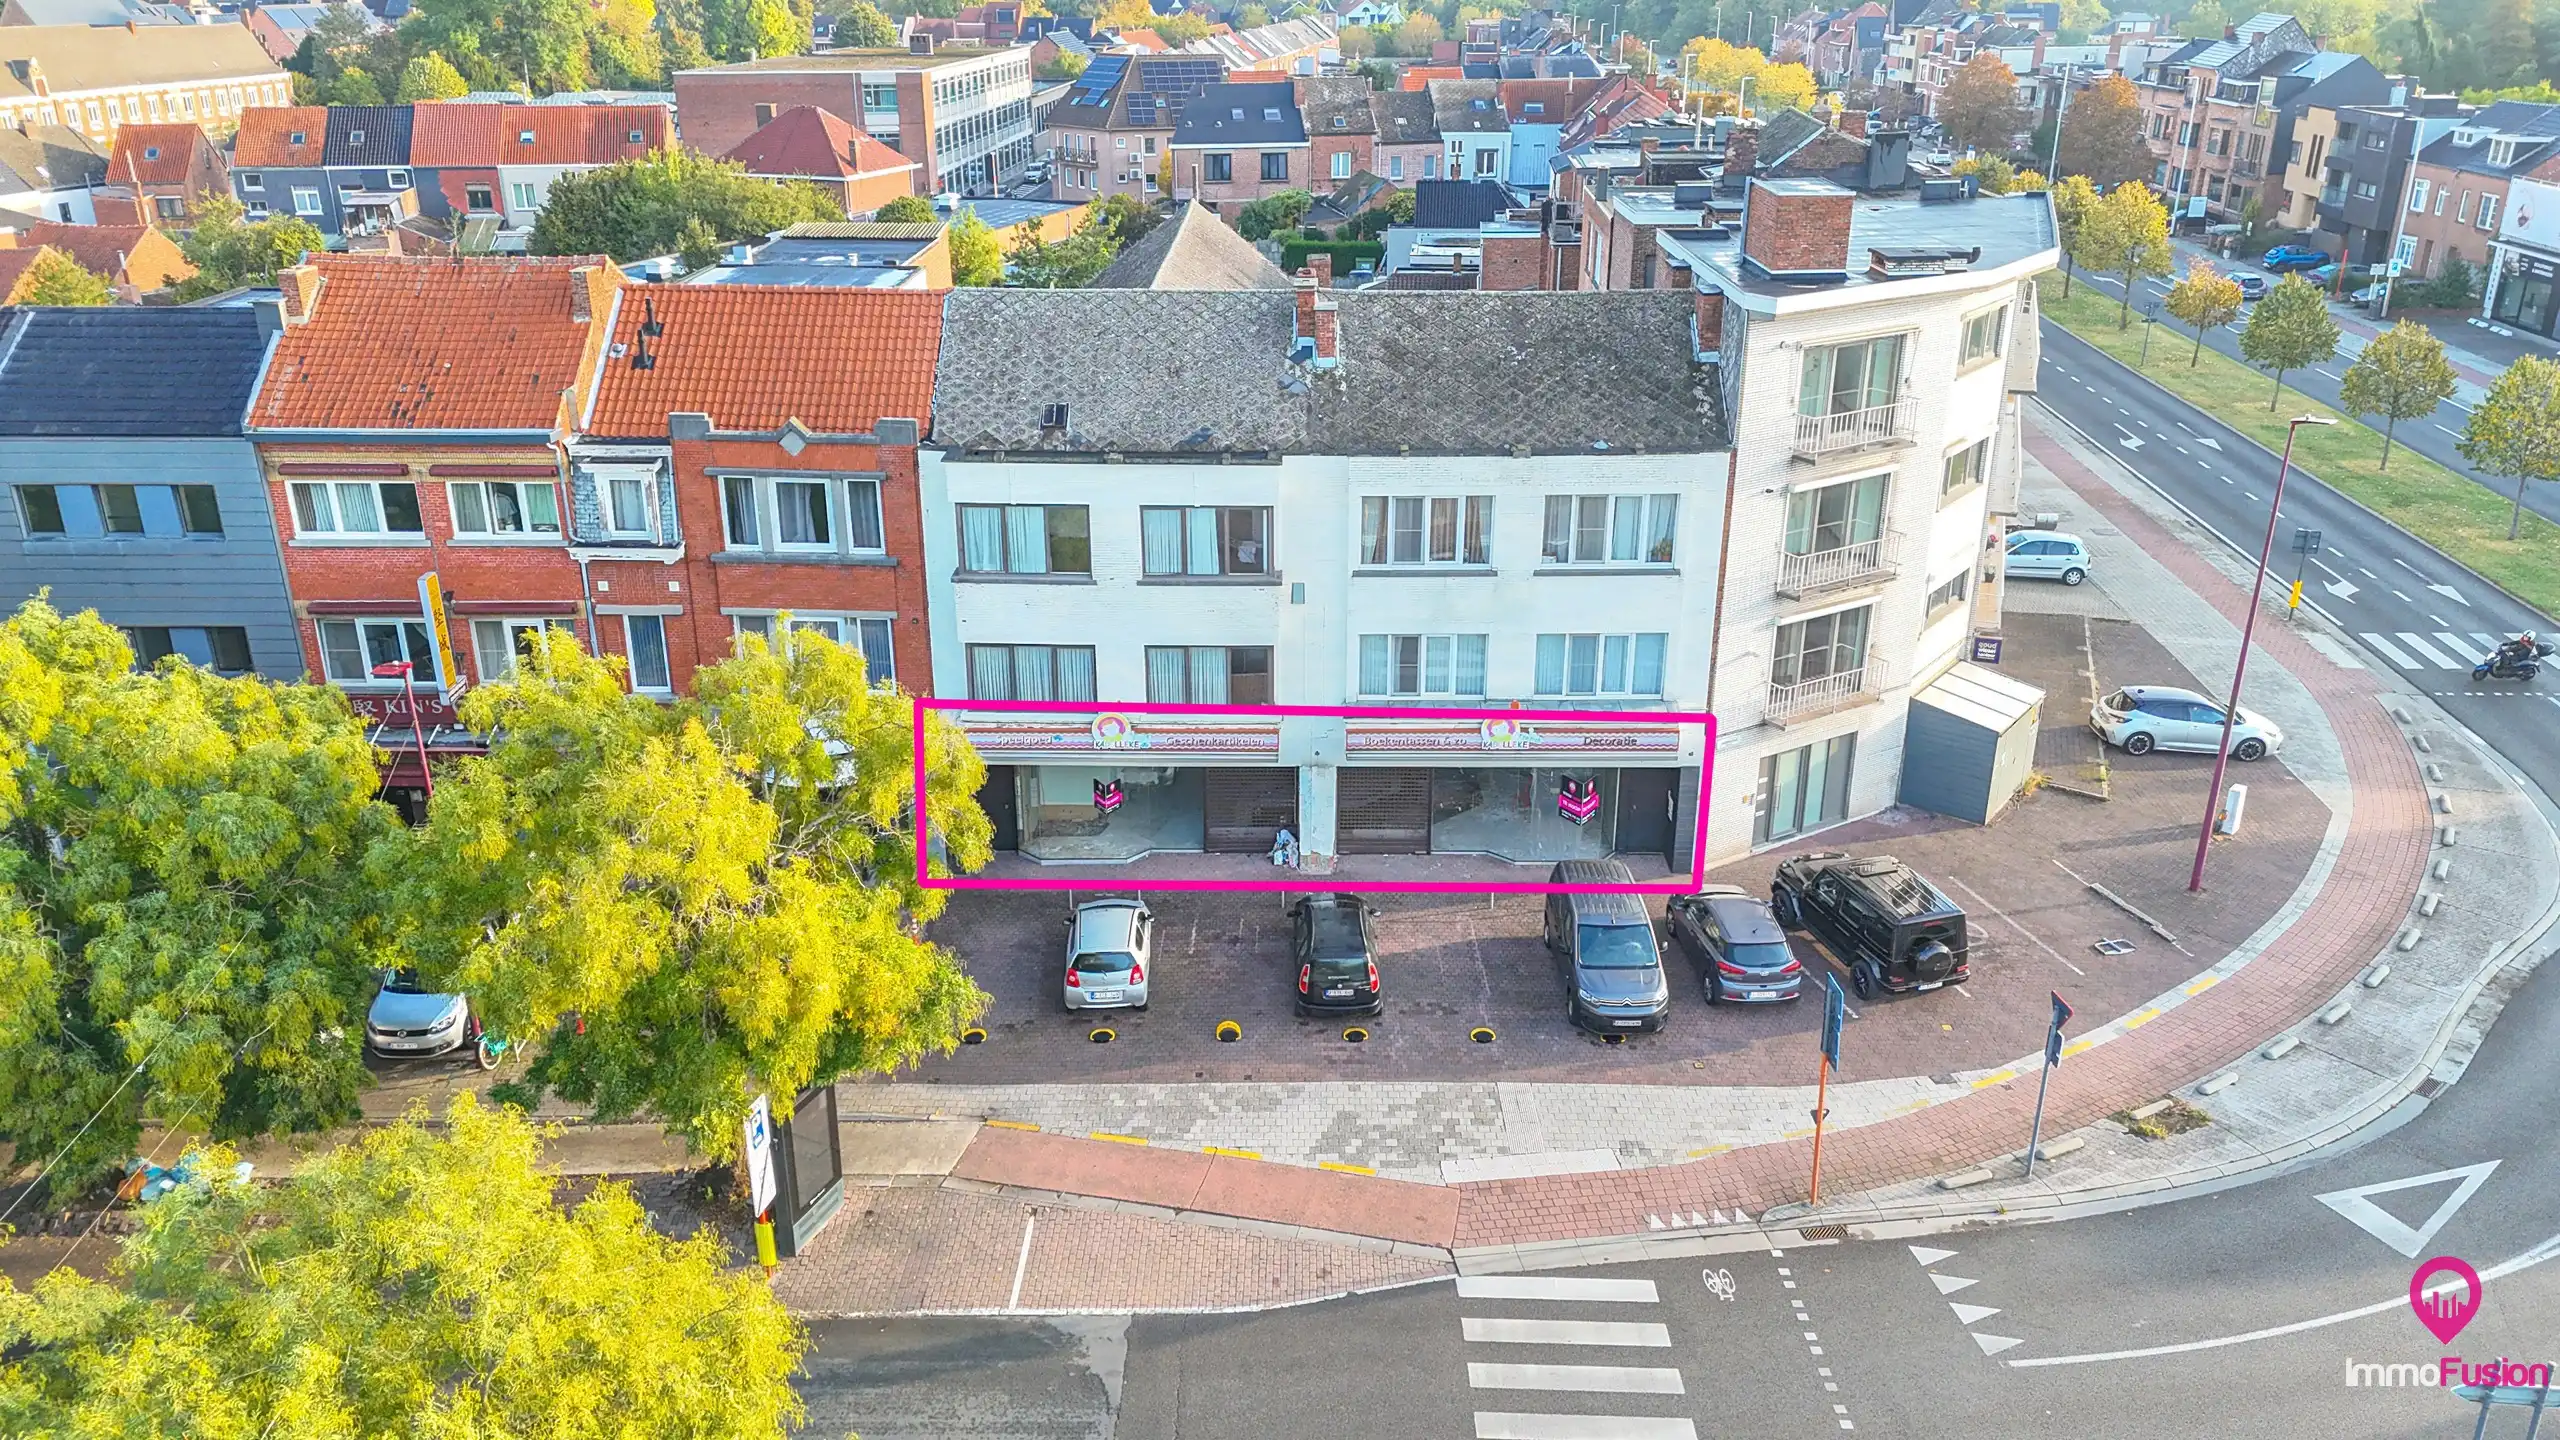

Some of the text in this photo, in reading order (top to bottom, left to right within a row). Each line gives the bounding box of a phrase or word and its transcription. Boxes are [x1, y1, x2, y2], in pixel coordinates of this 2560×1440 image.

[384, 699, 443, 714] KIN'S
[996, 735, 1053, 746] Speelgoed
[1166, 736, 1266, 747] Geschenkartikelen
[1364, 736, 1441, 746] Boekentassen
[1583, 736, 1638, 747] Decoratie
